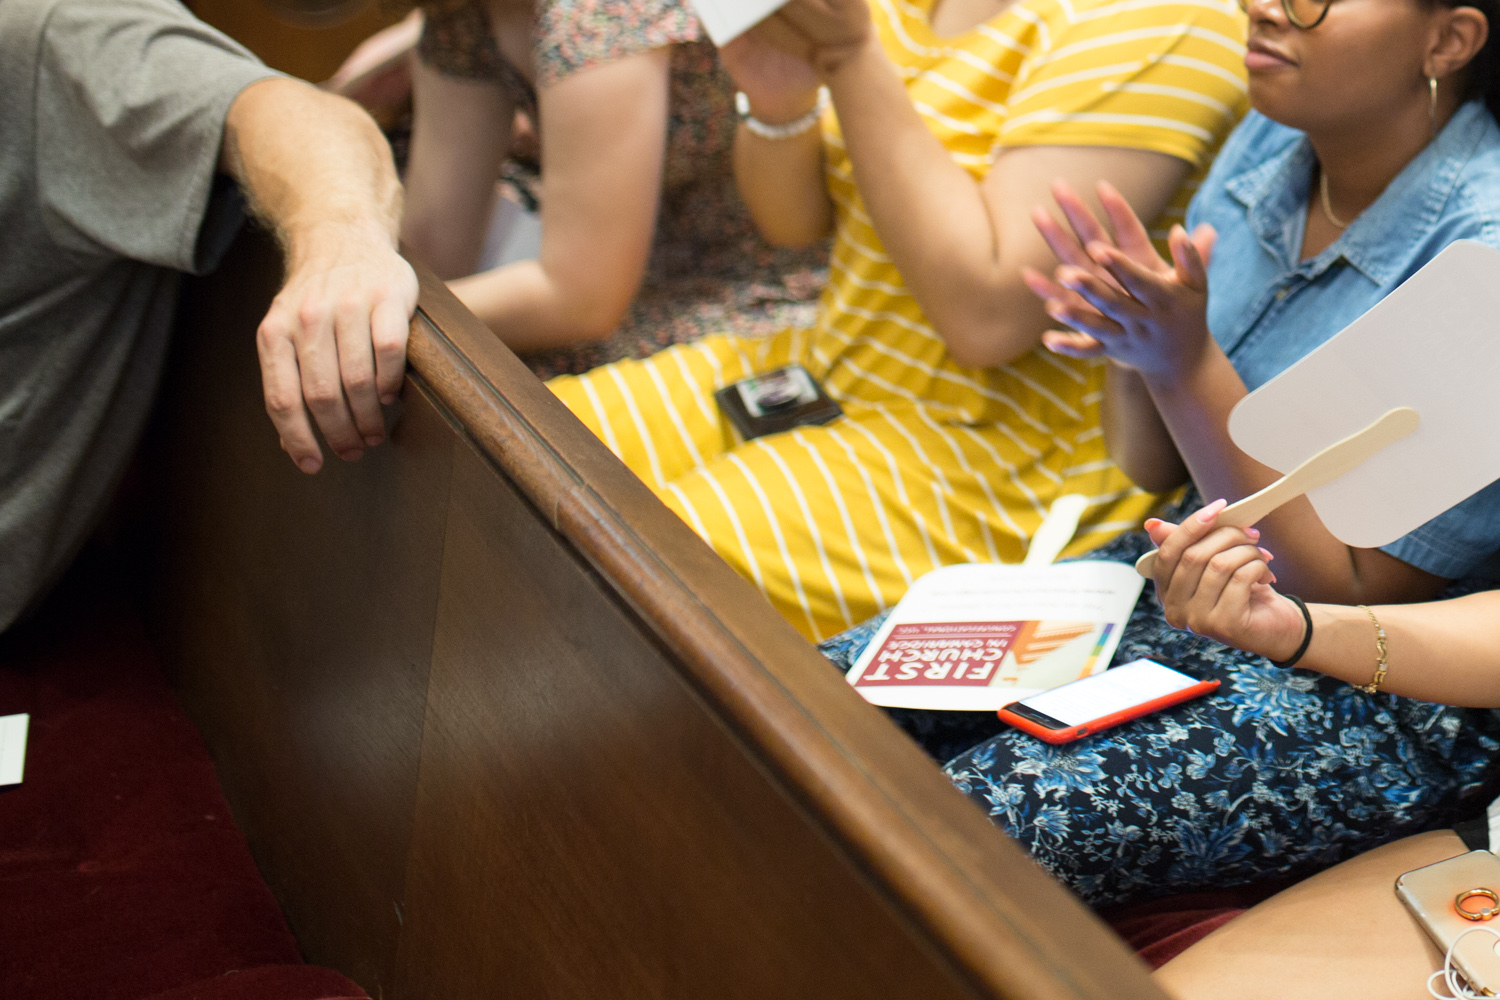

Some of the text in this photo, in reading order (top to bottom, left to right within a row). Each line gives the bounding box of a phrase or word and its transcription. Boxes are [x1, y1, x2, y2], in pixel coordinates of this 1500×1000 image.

[888, 639, 1009, 649] IN CAMBRIDGE
[878, 648, 1003, 662] CHURCH
[863, 662, 995, 680] FIRST
